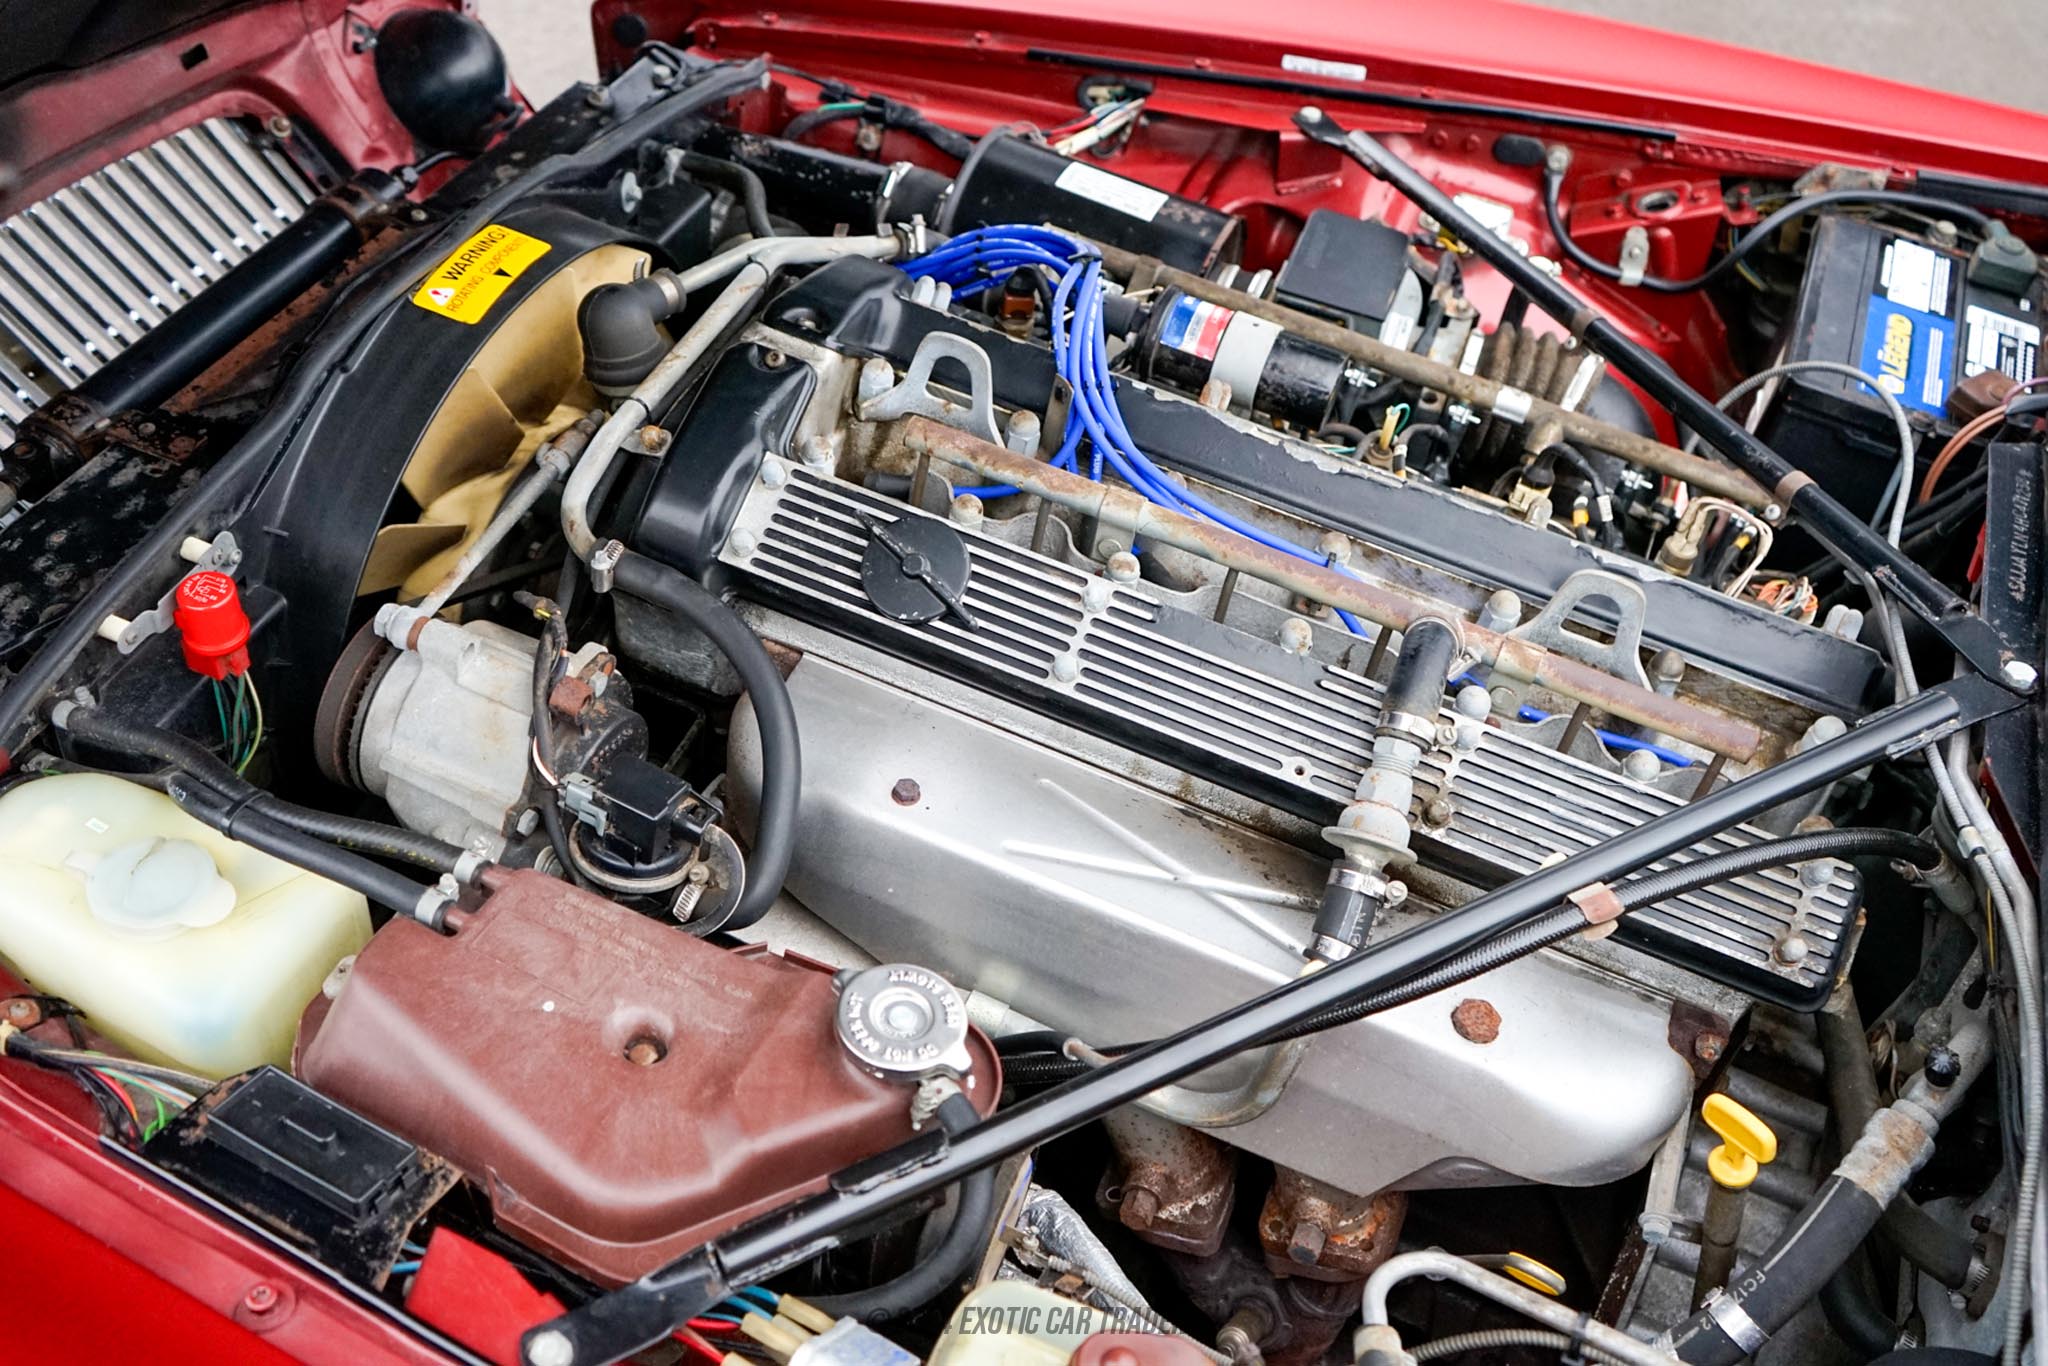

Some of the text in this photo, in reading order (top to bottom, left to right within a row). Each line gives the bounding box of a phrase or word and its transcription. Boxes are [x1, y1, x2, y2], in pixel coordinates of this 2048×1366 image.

[442, 228, 510, 281] WARNING!
[447, 275, 484, 313] ROTATING
[1880, 313, 1912, 379] LEGEND
